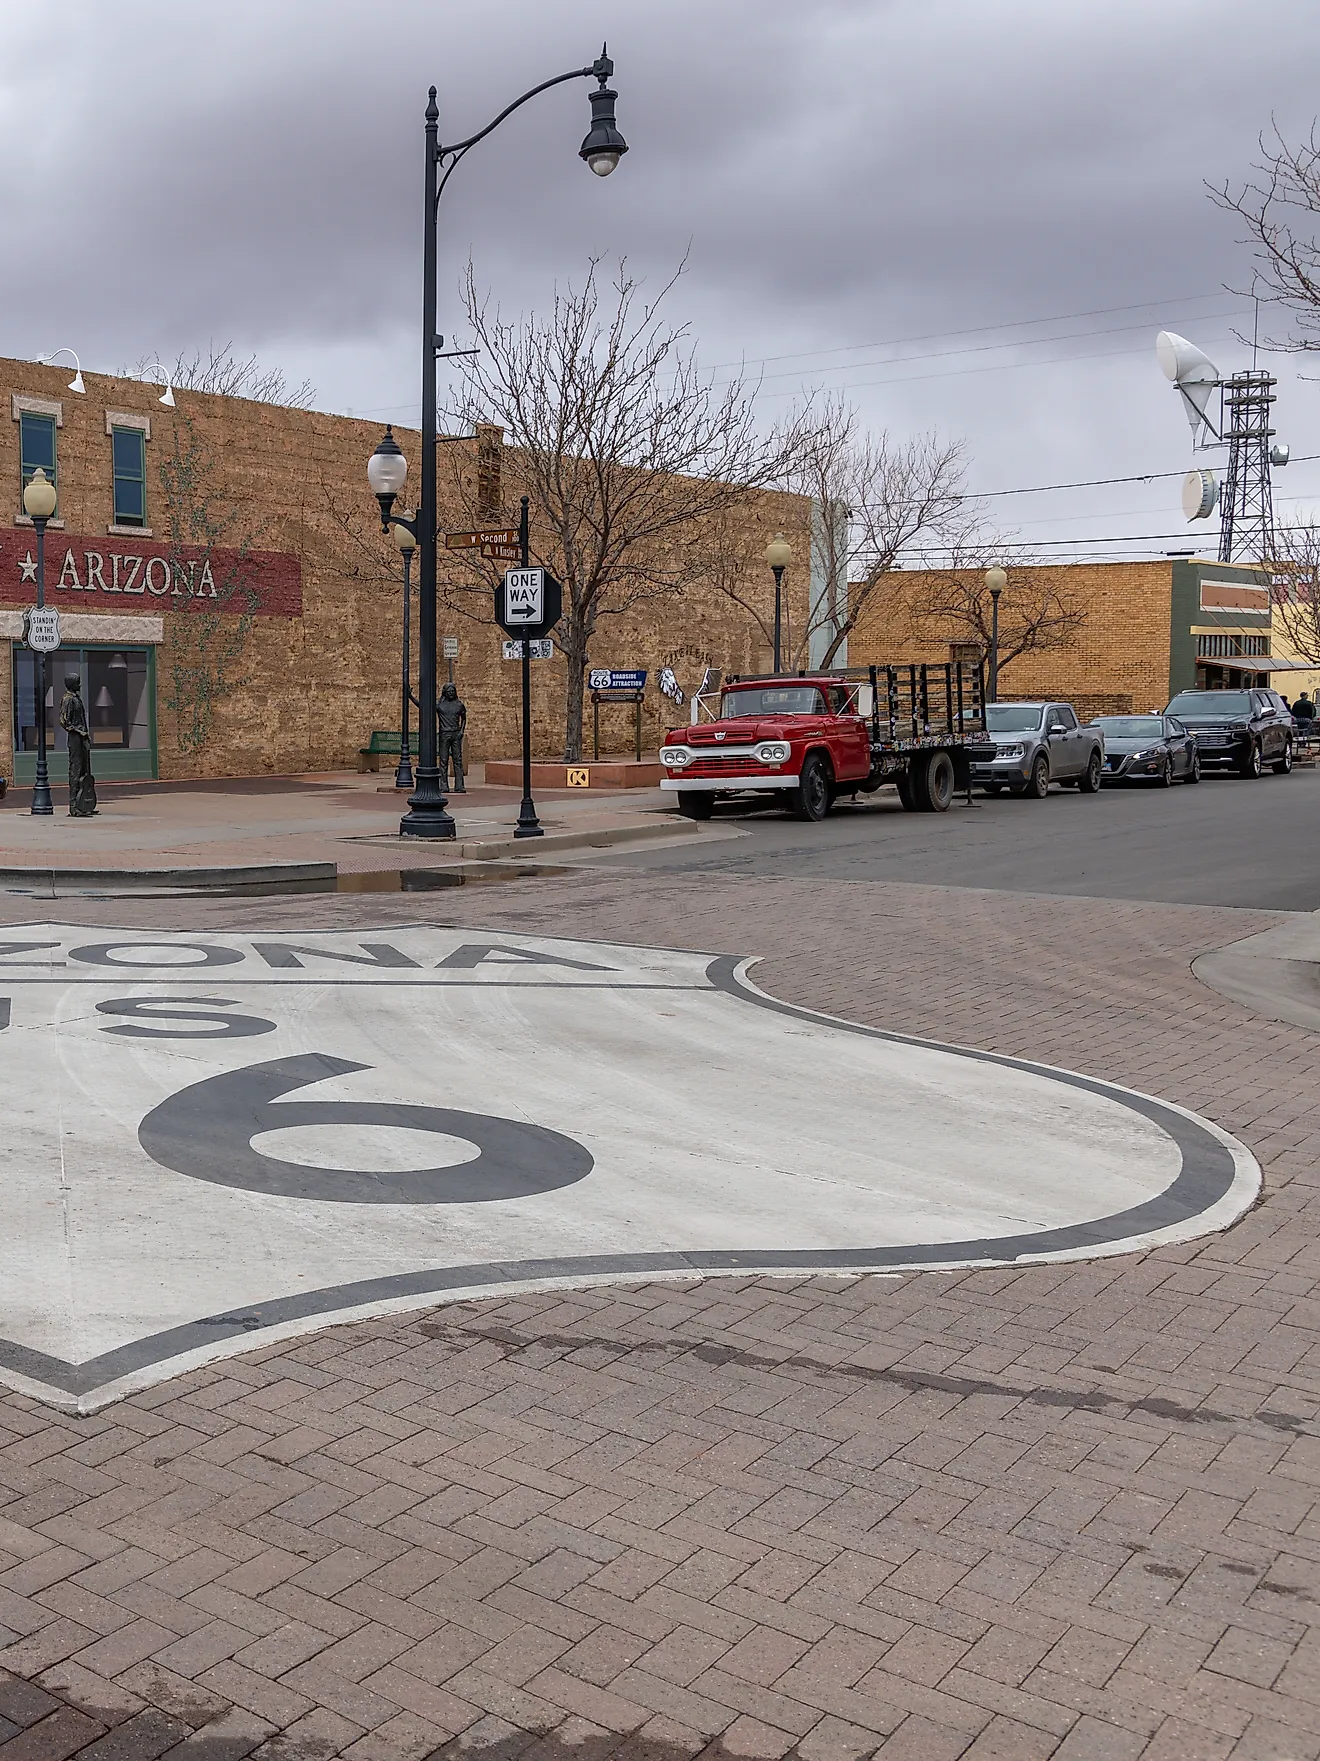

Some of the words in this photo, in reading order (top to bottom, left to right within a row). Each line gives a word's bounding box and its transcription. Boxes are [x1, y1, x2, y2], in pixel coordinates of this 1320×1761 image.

[470, 535, 477, 544] W
[480, 532, 508, 543] Second
[56, 548, 218, 598] ARIZONA
[510, 573, 538, 587] ONE
[509, 588, 539, 602] WAY
[32, 616, 57, 624] STANDIN'
[35, 626, 43, 634] ON
[44, 626, 54, 634] THE
[34, 635, 55, 643] CORNER
[593, 675, 609, 687] 66
[570, 770, 586, 786] K
